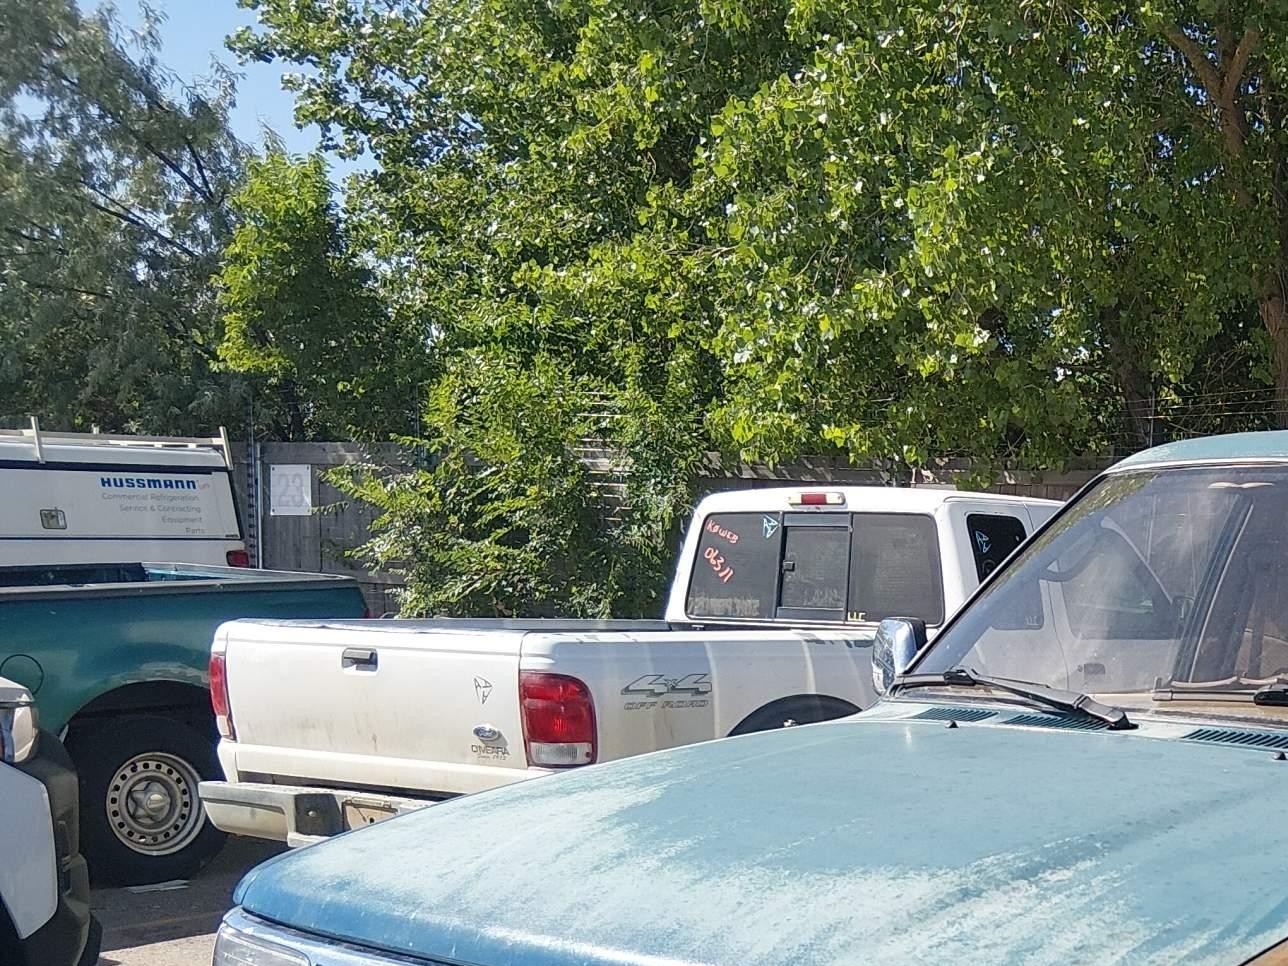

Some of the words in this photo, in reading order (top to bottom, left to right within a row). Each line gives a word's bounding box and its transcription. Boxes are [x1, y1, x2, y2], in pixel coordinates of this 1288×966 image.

[100, 477, 197, 490] HUSSMANN
[624, 701, 657, 711] OFF
[661, 699, 709, 709] ROAD
